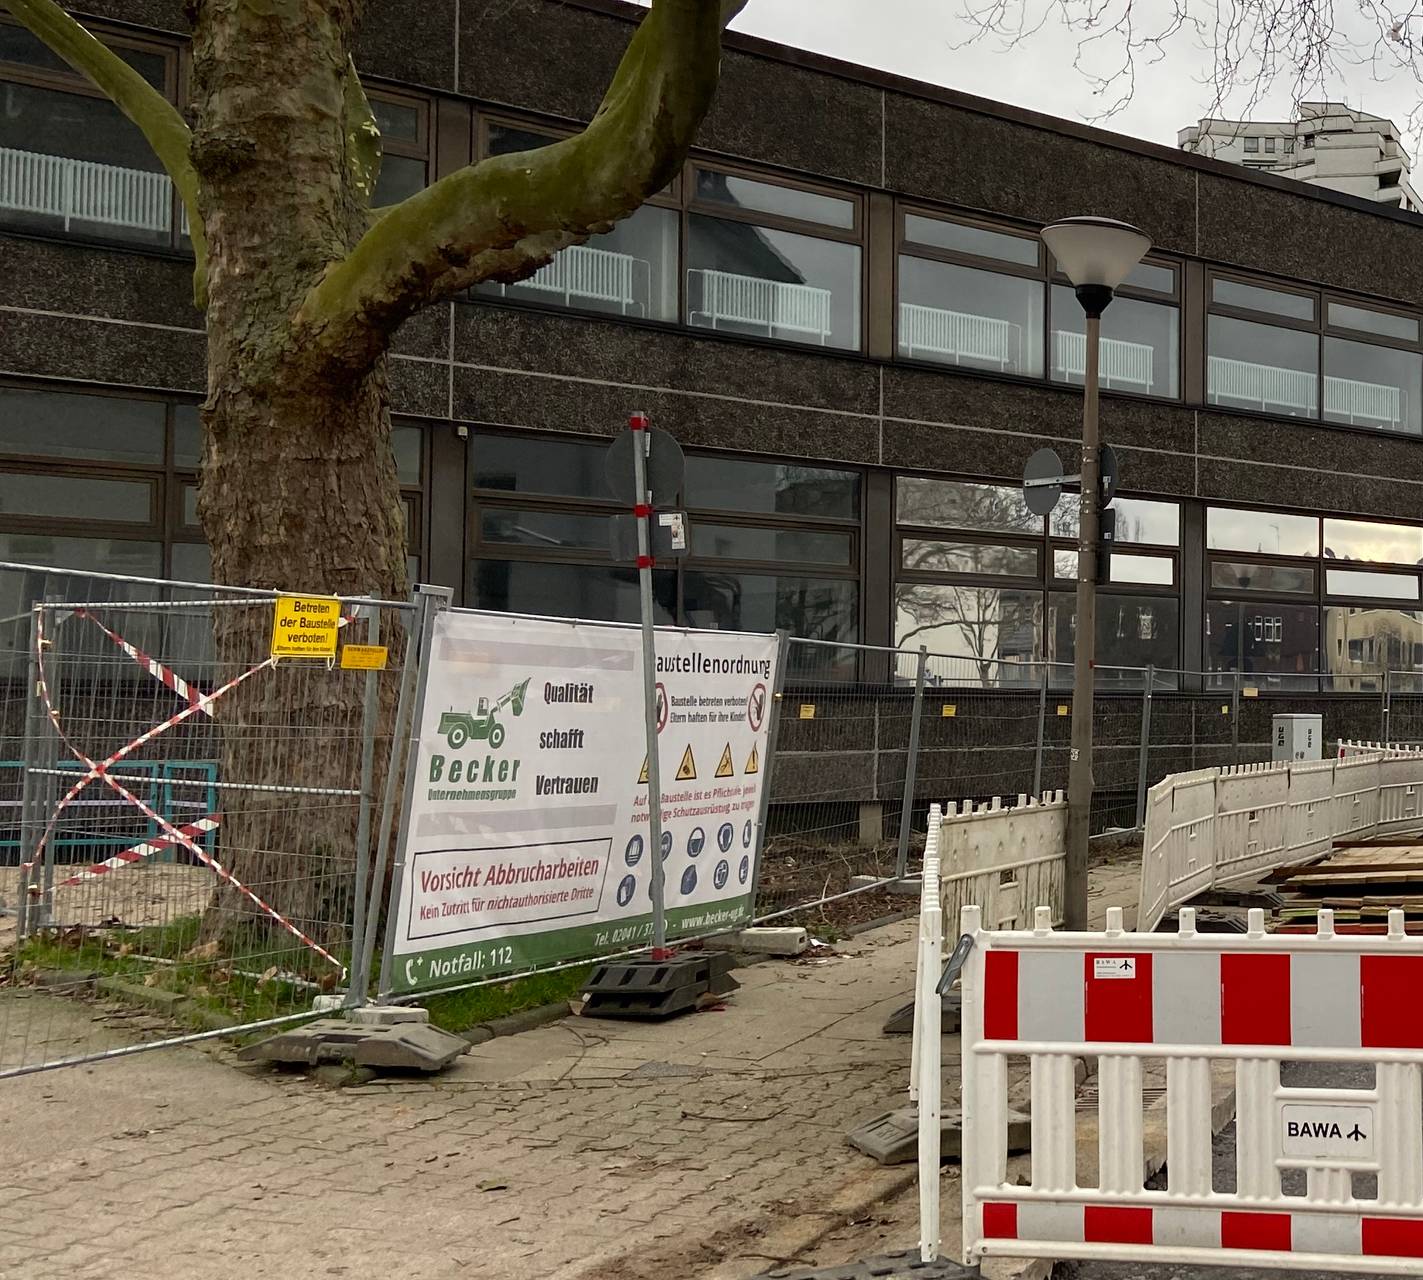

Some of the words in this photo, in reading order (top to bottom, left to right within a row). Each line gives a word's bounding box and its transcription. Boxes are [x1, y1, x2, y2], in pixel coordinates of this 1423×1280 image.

[293, 600, 330, 613] Betreten
[280, 616, 297, 627] der
[299, 617, 336, 629] Baustelle
[287, 632, 328, 643] verboten!
[655, 652, 771, 680] austellenordnung
[544, 681, 594, 705] Qualität
[671, 695, 698, 707] Baustelle
[699, 696, 724, 707] betreten
[670, 712, 687, 723] Eltern
[688, 711, 708, 722] haften
[709, 711, 719, 722] für
[720, 711, 729, 722] ihre
[539, 728, 585, 749] schafft
[429, 754, 521, 783] Becker
[428, 788, 517, 801] Unternehmensgruppe
[536, 774, 599, 796] Vertrauen
[633, 794, 648, 807] Auf
[661, 790, 692, 803] Baustelle
[693, 789, 703, 800] ist
[704, 789, 712, 800] es
[731, 802, 740, 811] zu
[421, 865, 481, 893] Vorsicht
[484, 857, 599, 886] Abbrucharbeiten
[420, 903, 440, 921] Kein
[441, 900, 470, 918] Zutritt
[471, 898, 485, 913] für
[486, 888, 570, 911] nichtauthorisierte
[571, 886, 594, 902] Dritte
[594, 930, 609, 946] Tel.
[612, 925, 636, 943] 02041
[681, 905, 745, 929] www.becker-ug.de
[429, 953, 486, 979] Notfall:
[490, 946, 513, 967] 112
[1288, 1122, 1342, 1139] BAWA
